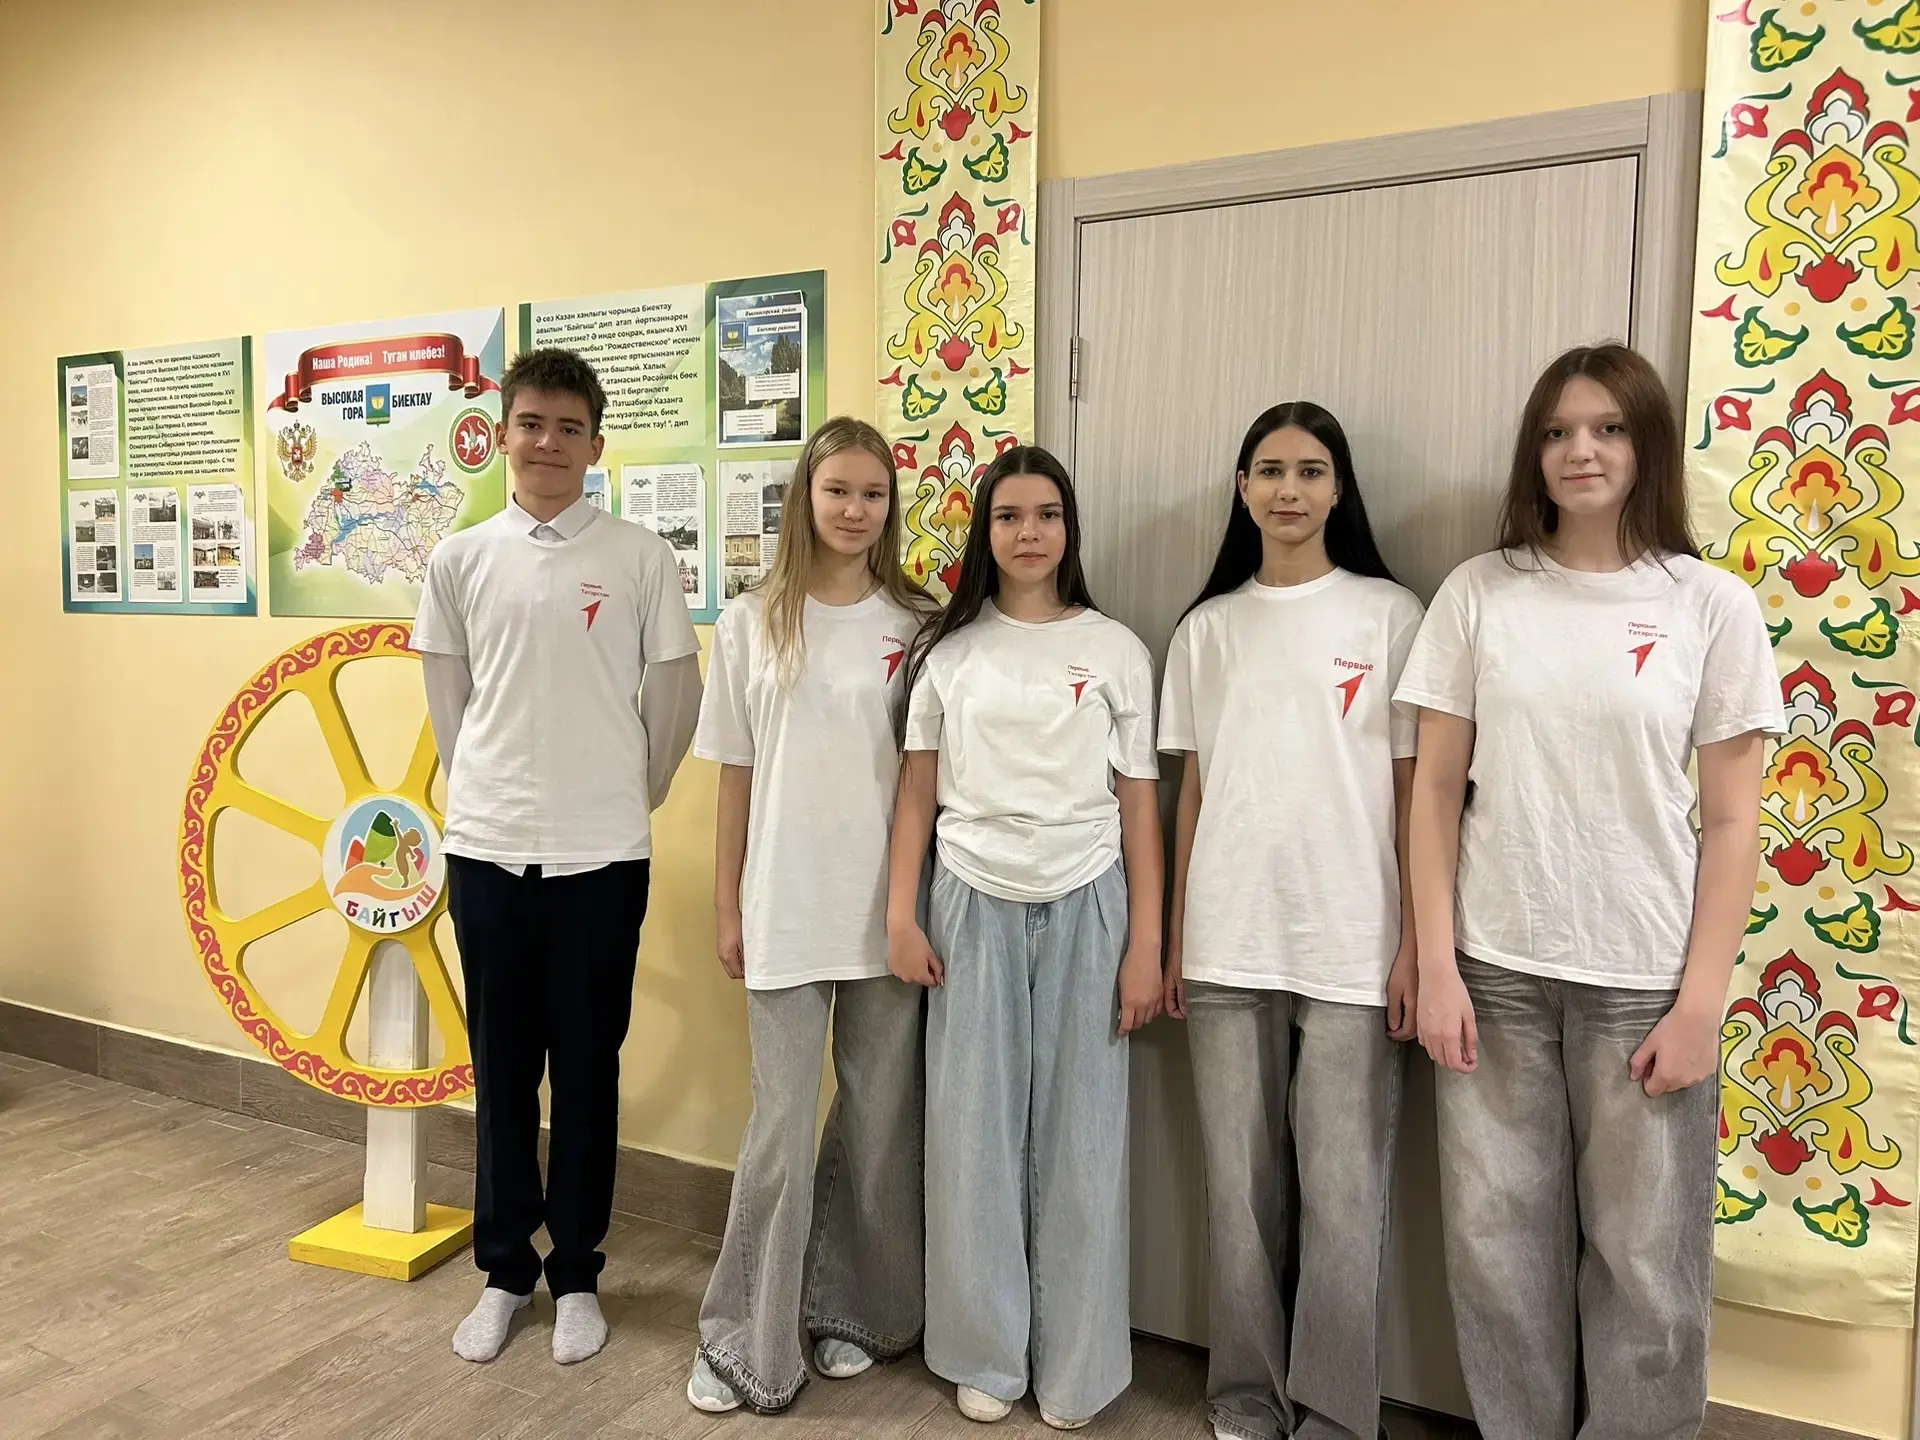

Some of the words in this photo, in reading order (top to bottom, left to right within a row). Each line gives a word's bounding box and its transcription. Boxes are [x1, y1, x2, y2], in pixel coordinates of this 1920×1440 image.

[577, 310, 607, 319] ханлыгы
[609, 307, 640, 317] чорында
[642, 303, 672, 313] Биектау
[536, 326, 562, 334] авылын
[564, 322, 597, 331] "Байгыш"
[599, 320, 612, 328] дип
[554, 334, 590, 344] идегезме?
[646, 326, 673, 335] якынча
[605, 339, 671, 351] "Рождественское"
[673, 336, 700, 344] исемен
[313, 357, 335, 370] Наша
[338, 352, 373, 369] Родина!
[382, 350, 407, 364] Туган
[409, 345, 445, 361] илебез!
[629, 351, 674, 361] яртысыннан
[322, 390, 363, 405] ВЫСОКАЯ
[392, 392, 432, 408] БИЕКТАУ
[343, 406, 363, 420] ГОРА
[1334, 658, 1374, 671] Первые
[345, 884, 437, 928] БАЙГЫШ
